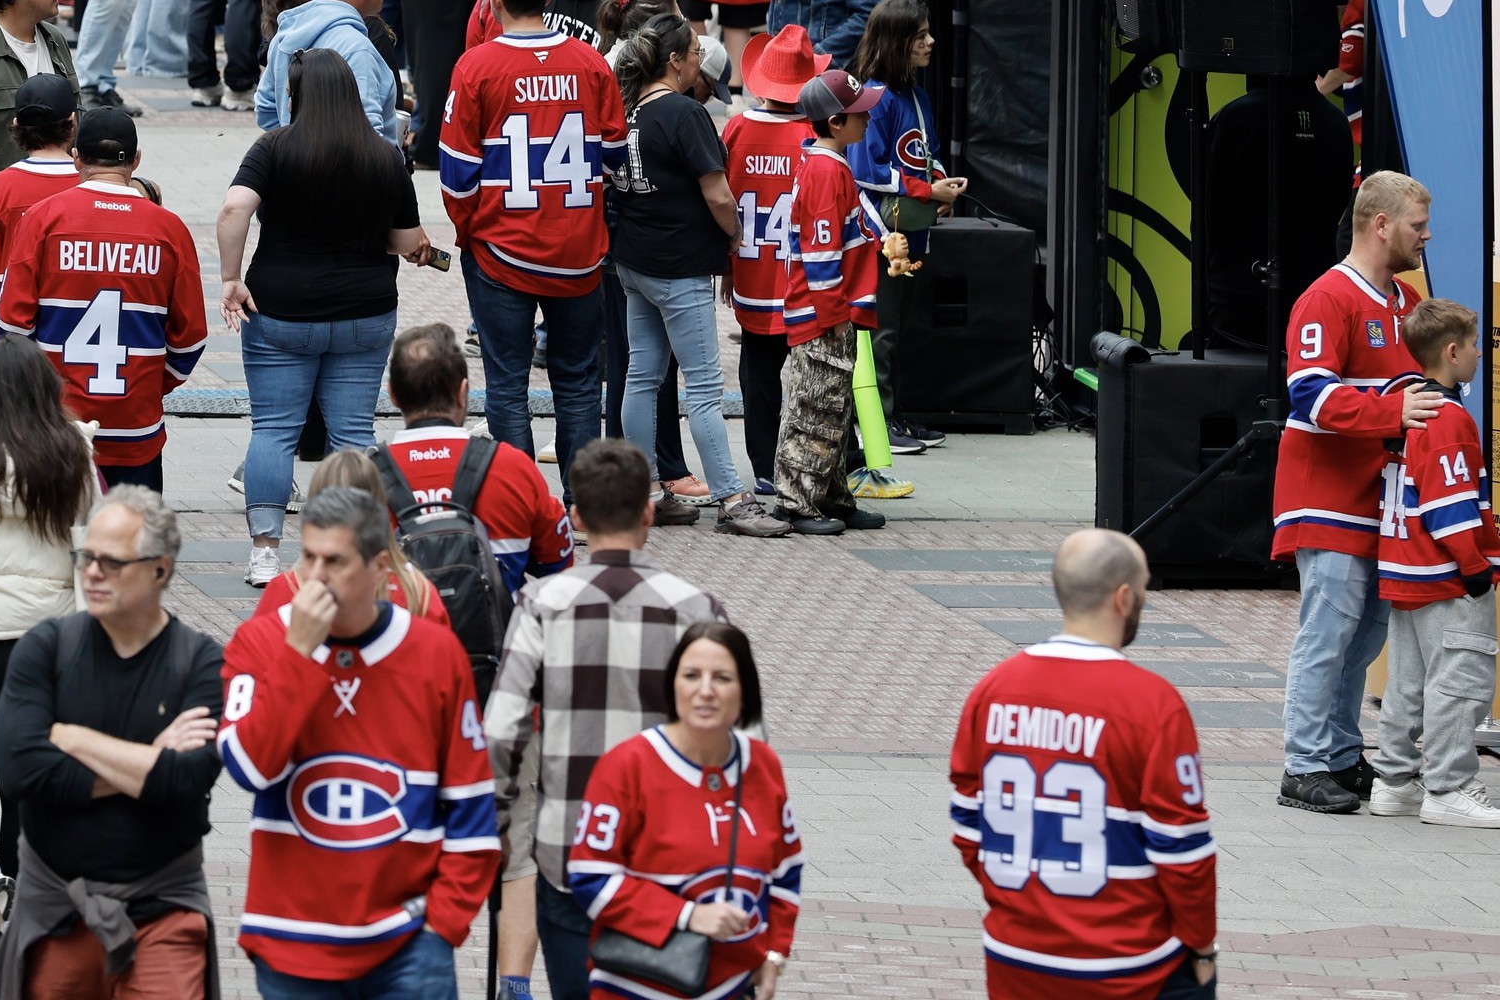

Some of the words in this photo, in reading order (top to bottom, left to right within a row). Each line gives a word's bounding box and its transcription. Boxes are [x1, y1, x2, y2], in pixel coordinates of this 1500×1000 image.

[513, 74, 579, 104] SUZUKI
[500, 111, 594, 211] 14
[745, 155, 791, 177] SUZUKI
[93, 200, 132, 212] Reebok
[58, 239, 162, 277] BELIVEAU
[61, 288, 129, 396] 4
[1299, 321, 1324, 361] 9
[1370, 337, 1386, 346] RBC
[409, 446, 451, 463] Reebok
[1438, 450, 1471, 488] 14
[224, 673, 256, 722] 8
[460, 699, 485, 752] 4
[984, 702, 1107, 759] DEMIDOV
[1174, 751, 1205, 808] 9
[981, 752, 1109, 899] 93
